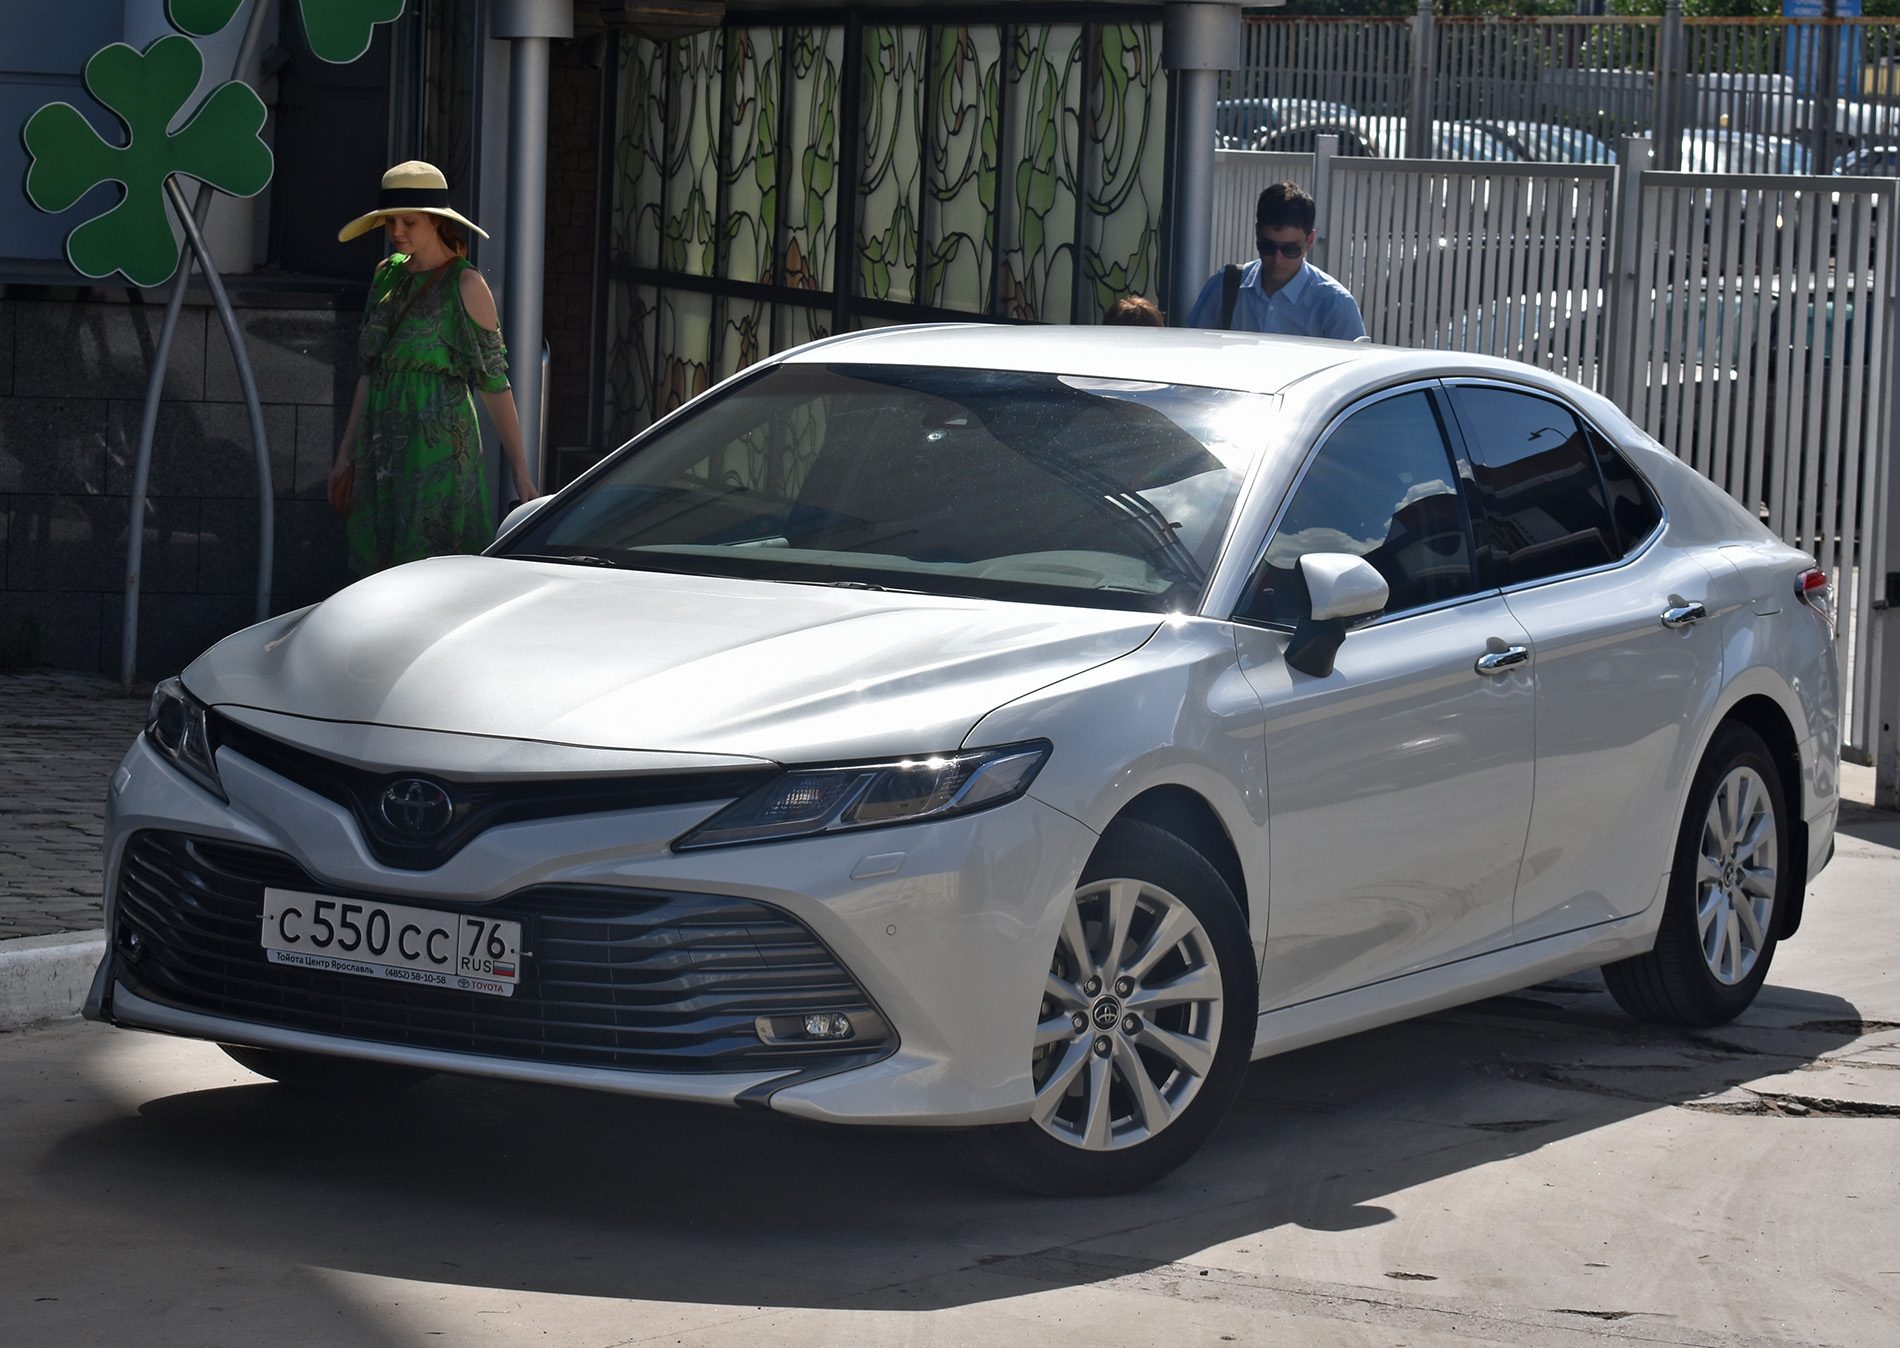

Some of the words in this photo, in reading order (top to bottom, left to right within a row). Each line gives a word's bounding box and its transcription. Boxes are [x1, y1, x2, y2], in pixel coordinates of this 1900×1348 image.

[466, 919, 506, 959] 76
[276, 952, 304, 964] Тойота
[305, 956, 330, 969] Центр
[331, 961, 374, 974] Ярославль
[385, 968, 410, 980] (4852)
[410, 972, 446, 985] 58-10-58
[461, 957, 492, 973] RUS
[471, 981, 504, 993] TOYOTA
